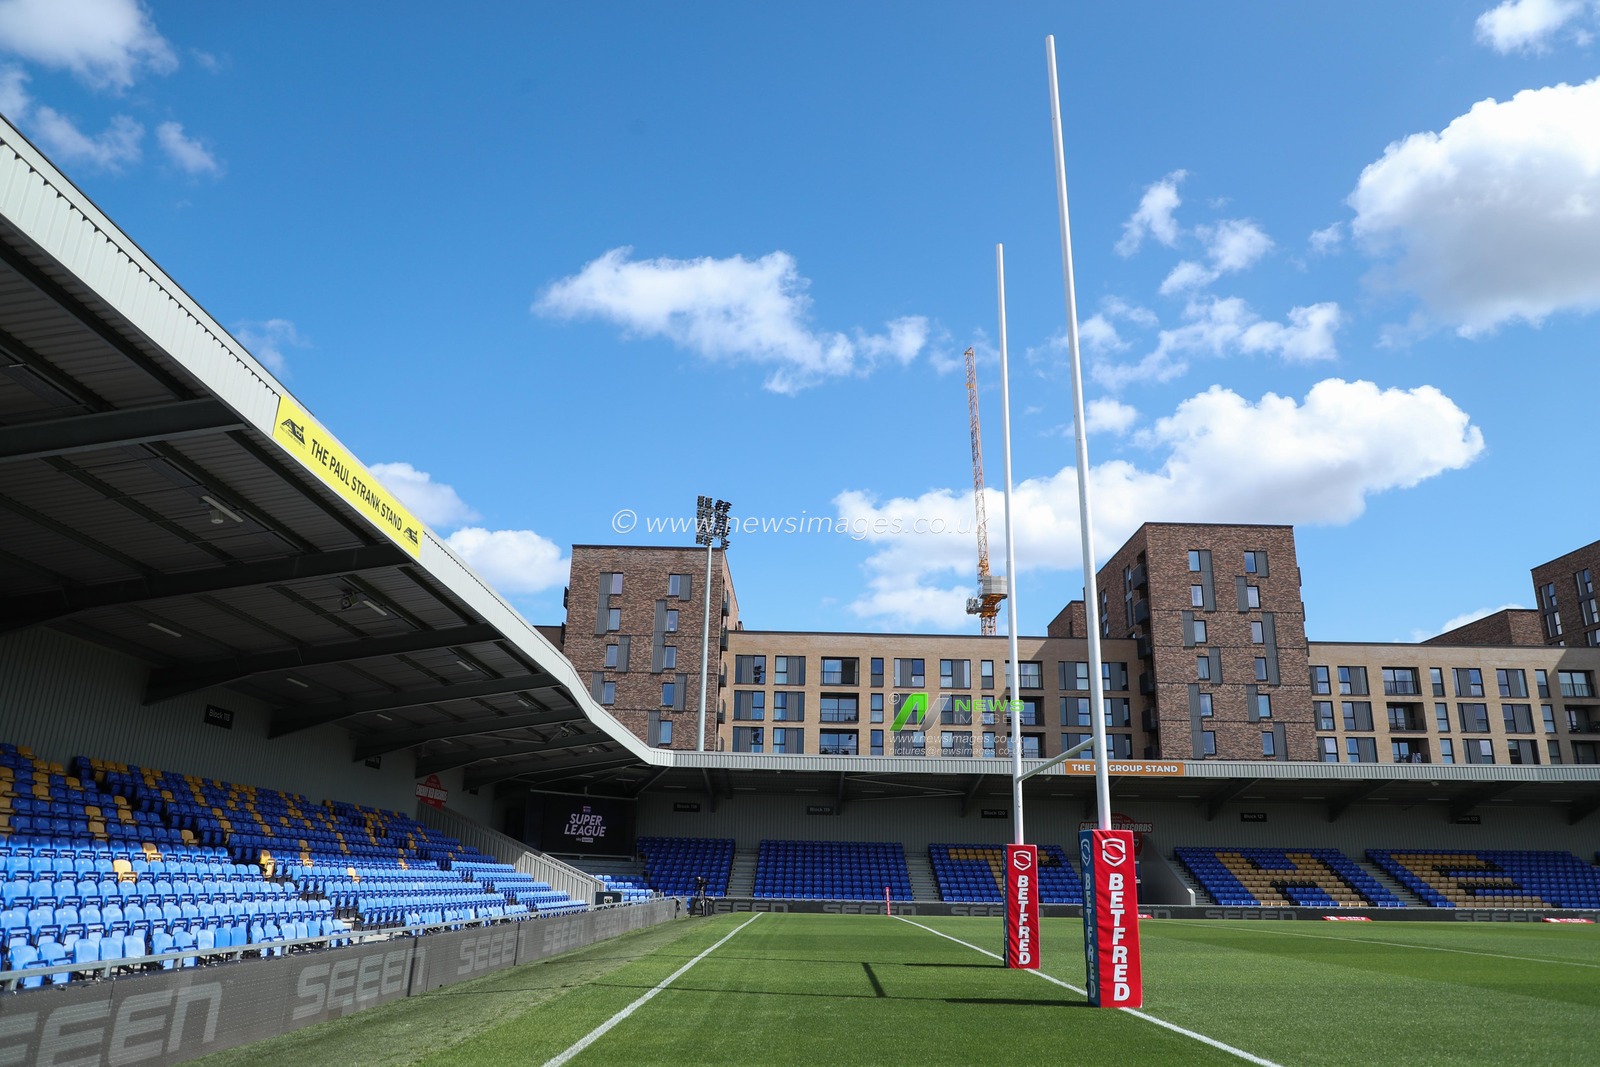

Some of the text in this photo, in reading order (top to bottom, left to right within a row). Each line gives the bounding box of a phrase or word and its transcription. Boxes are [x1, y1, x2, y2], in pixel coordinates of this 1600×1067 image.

[311, 439, 402, 531] THE PAUL STRANK STAND
[1071, 764, 1091, 772] THE
[1109, 764, 1143, 772] GROUP
[1145, 765, 1178, 773] STAND
[564, 824, 606, 837] LEAGUE
[569, 813, 602, 826] SUPER
[1017, 875, 1031, 965] BETFRED
[1085, 873, 1096, 998] BETFRED
[1108, 873, 1130, 1001] BETFRED
